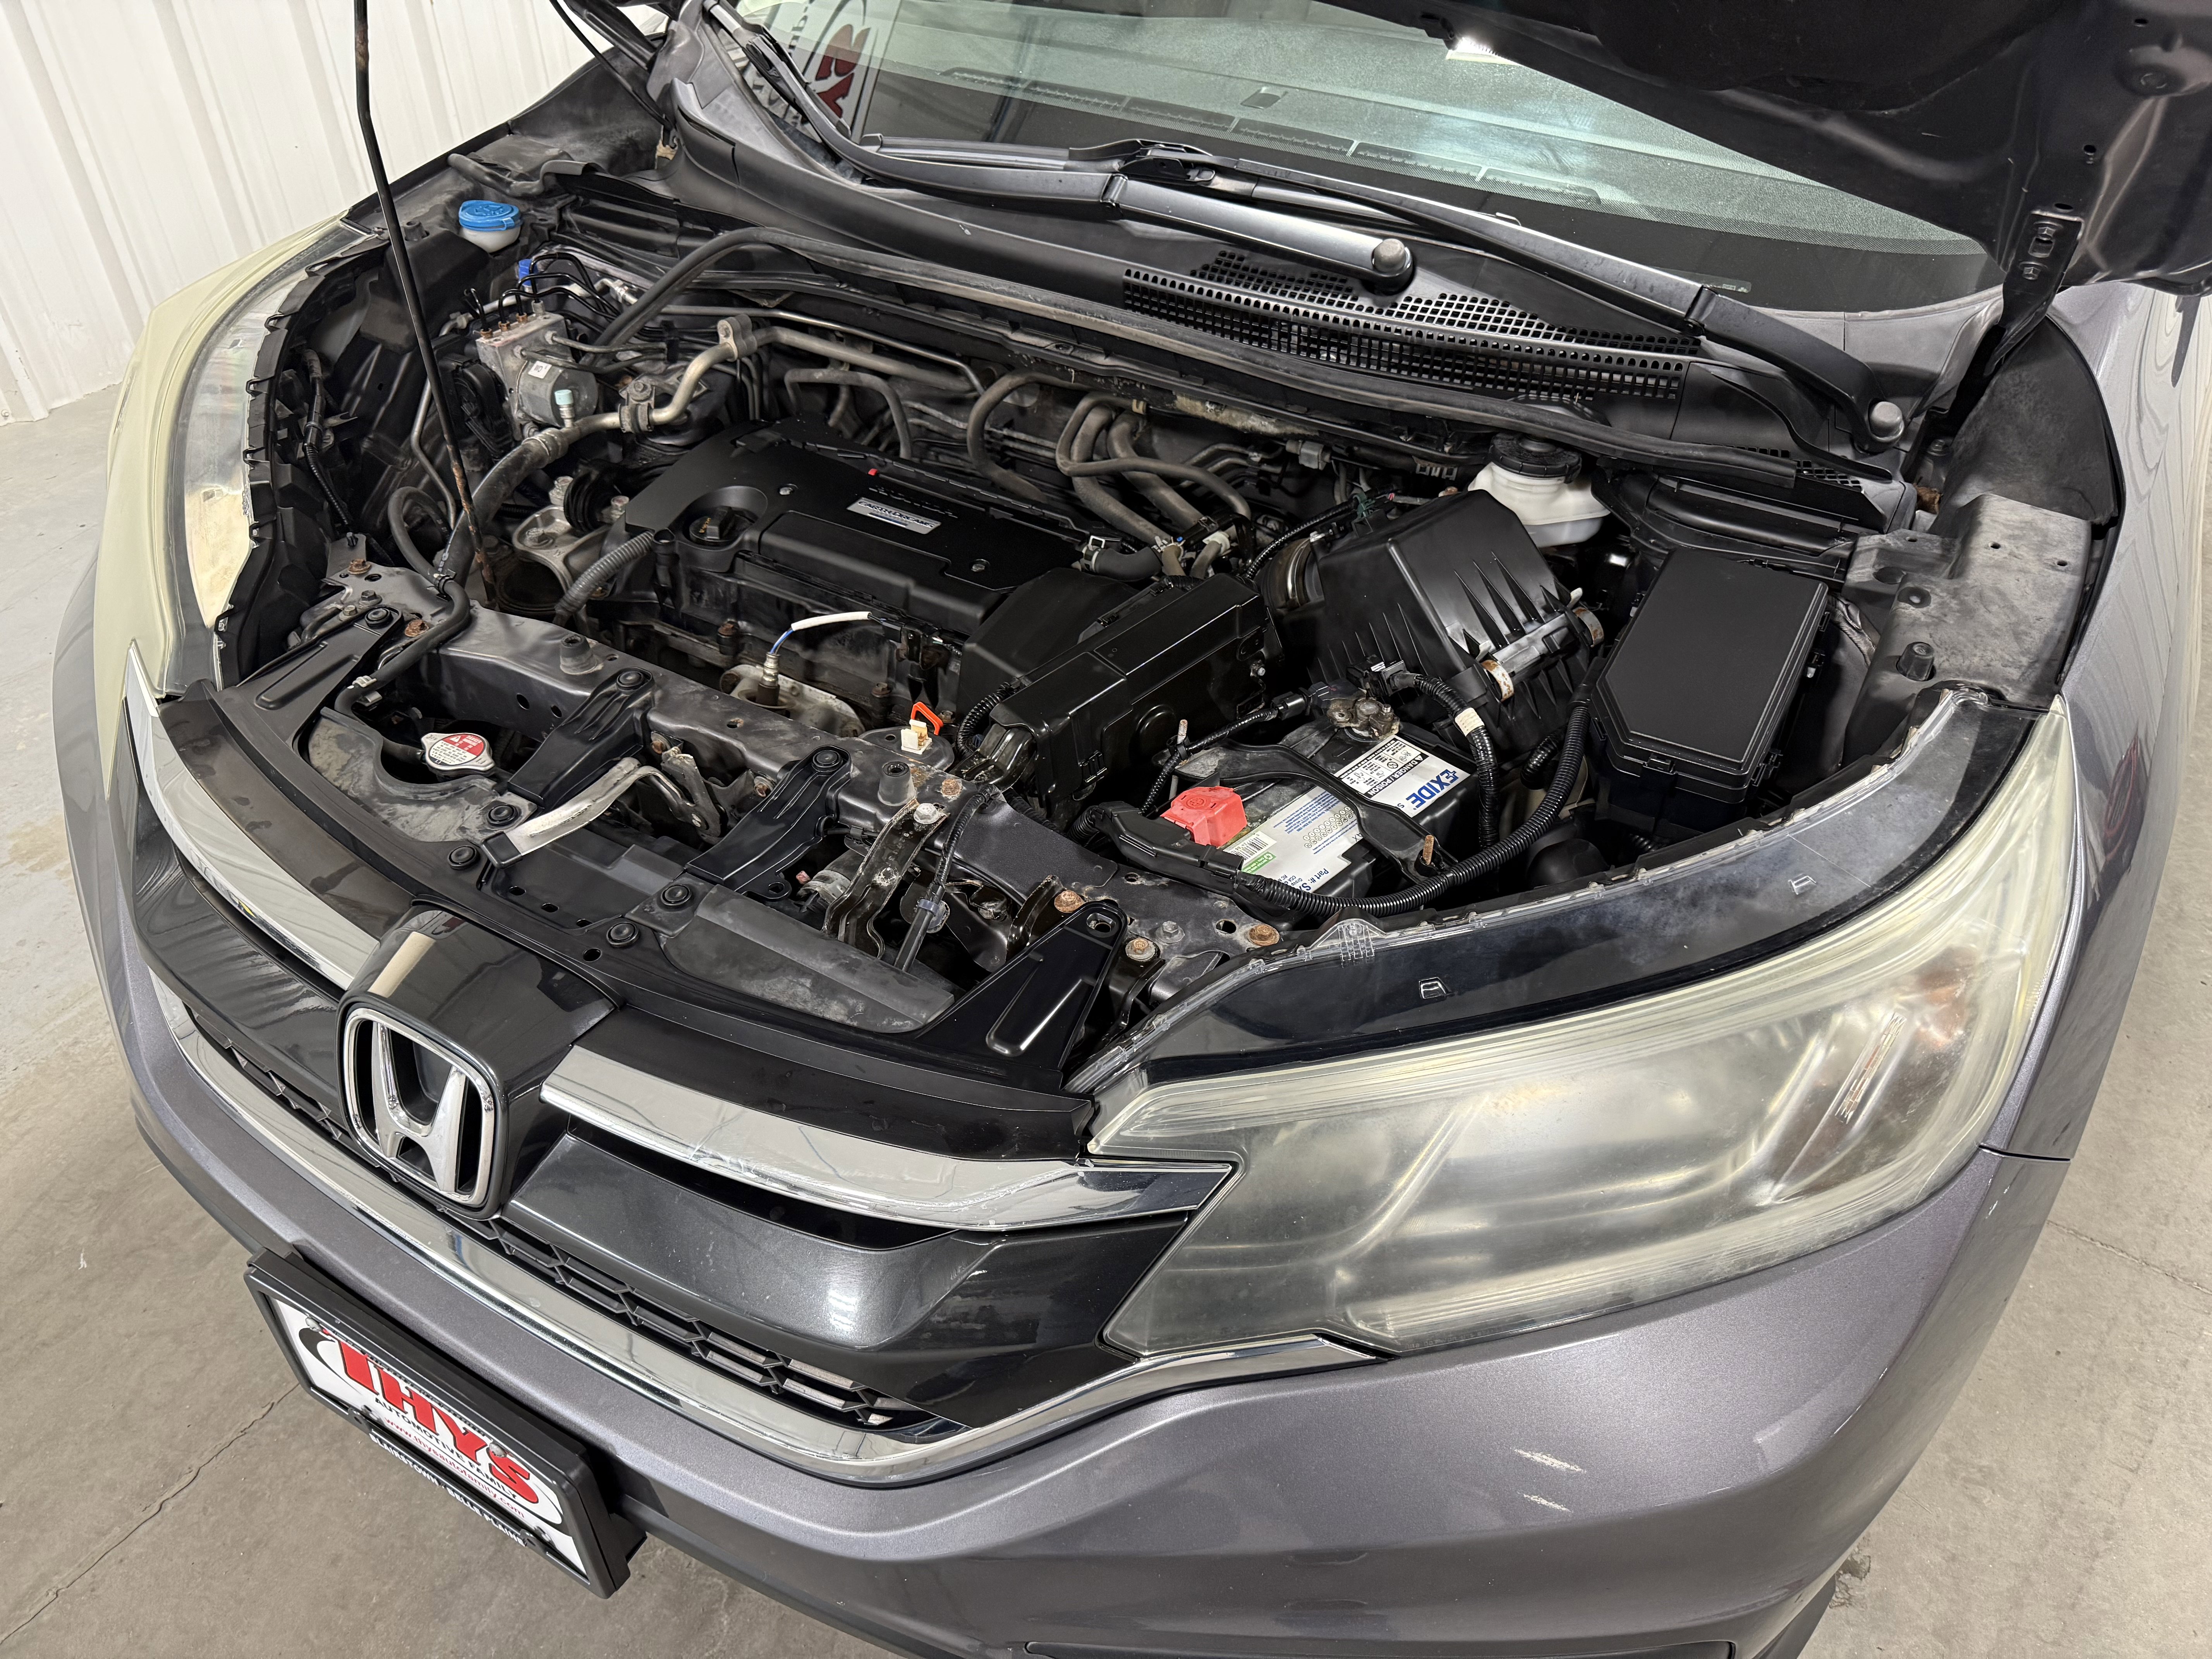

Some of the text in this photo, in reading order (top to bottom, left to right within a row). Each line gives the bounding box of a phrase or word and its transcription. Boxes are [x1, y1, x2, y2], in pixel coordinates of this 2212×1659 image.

[892, 512, 934, 528] DREAMS
[1393, 760, 1418, 779] DANGER
[1368, 777, 1393, 796] POISON
[1406, 769, 1459, 809] EXIDE
[1291, 878, 1303, 886] Group
[1315, 868, 1329, 879] Part
[322, 1328, 539, 1504] THYS
[375, 1396, 519, 1499] AUTOMOTIVE FAMILY
[384, 1417, 526, 1518] www.thysautofamily.com
[369, 1432, 527, 1547] BLAIRSTOWN BELLE PLAINE
